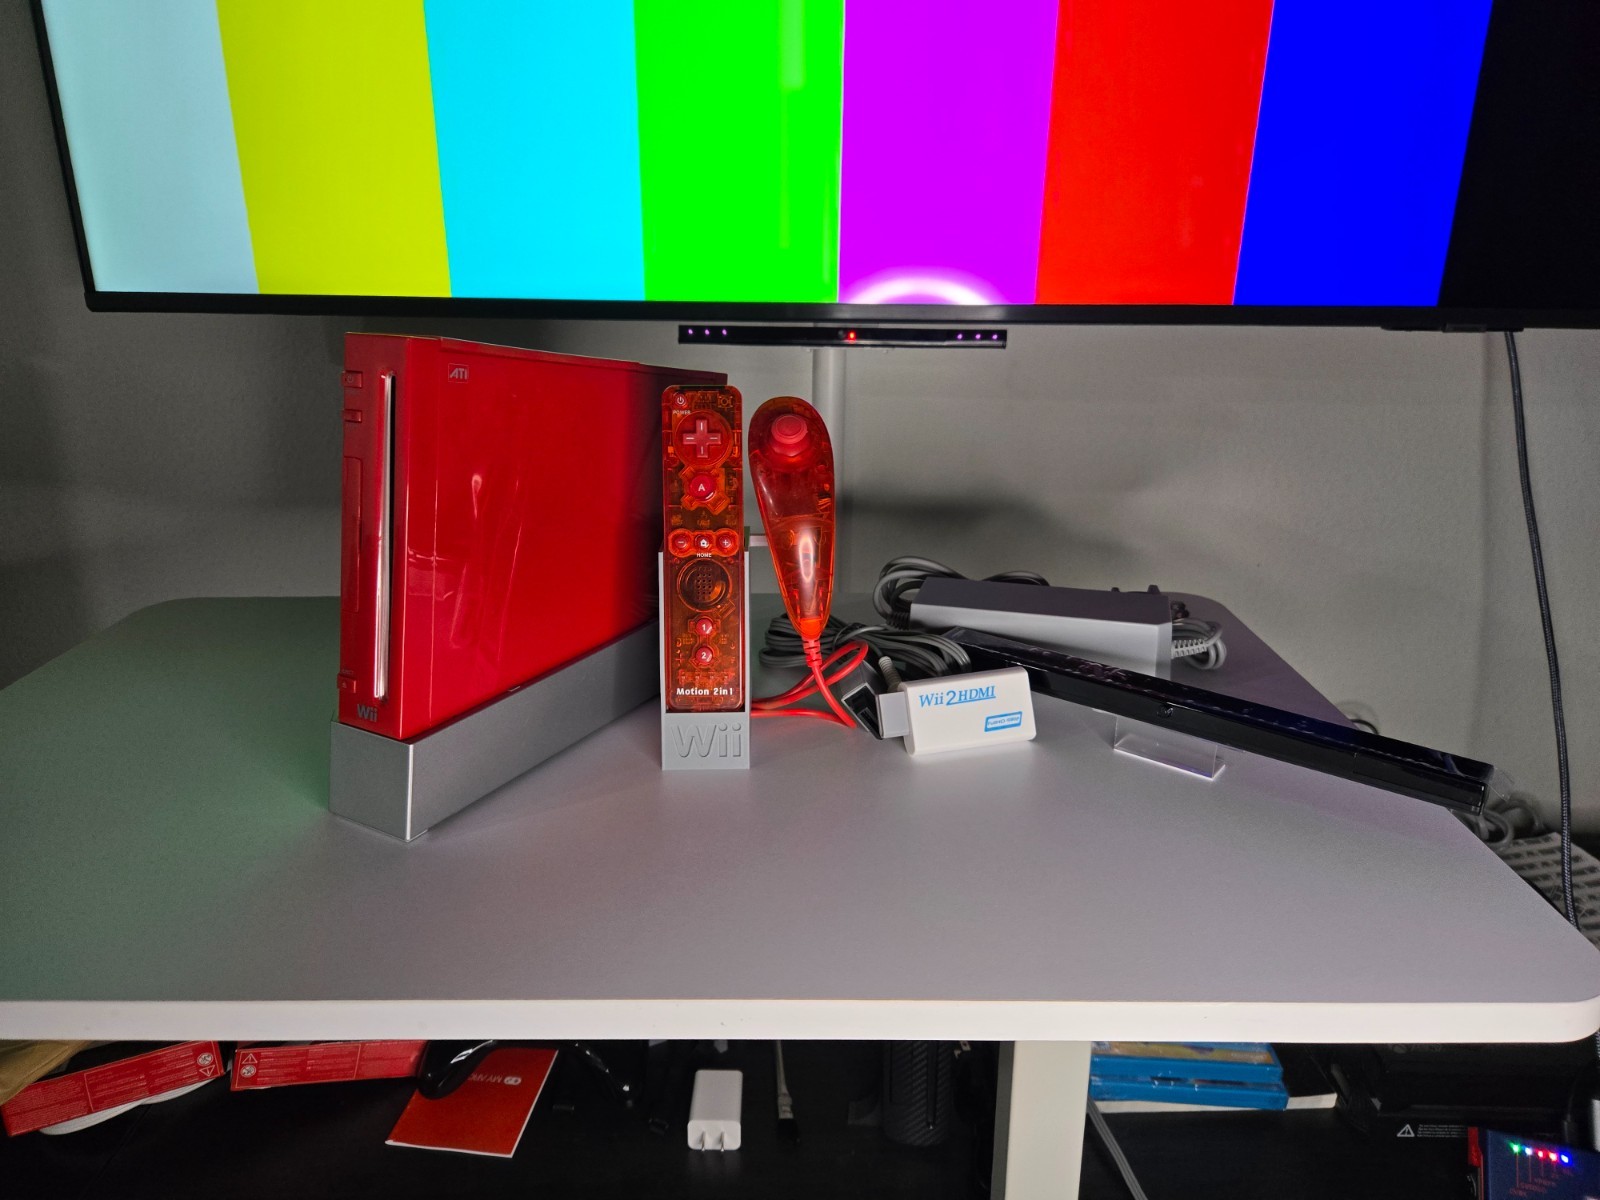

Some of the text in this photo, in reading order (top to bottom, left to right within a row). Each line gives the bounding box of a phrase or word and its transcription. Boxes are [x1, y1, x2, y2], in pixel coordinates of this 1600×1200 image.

[449, 367, 468, 380] ATI
[697, 483, 706, 492] A
[701, 623, 707, 631] 1
[701, 651, 707, 660] 2
[676, 687, 710, 696] Motion
[357, 703, 378, 723] Wii
[670, 721, 742, 758] Wii
